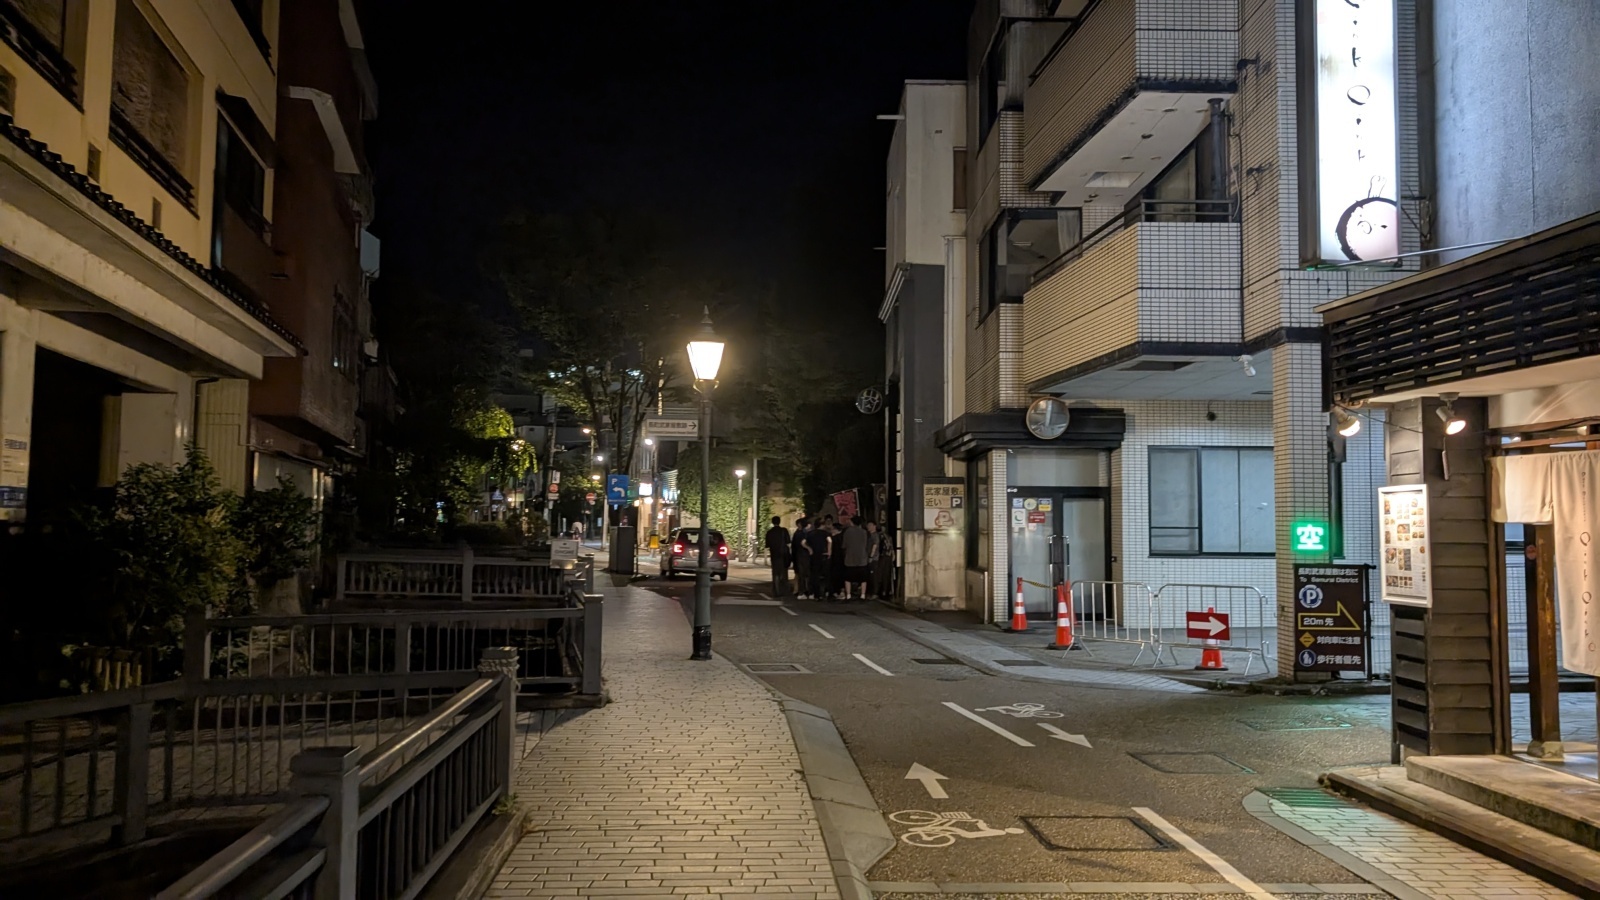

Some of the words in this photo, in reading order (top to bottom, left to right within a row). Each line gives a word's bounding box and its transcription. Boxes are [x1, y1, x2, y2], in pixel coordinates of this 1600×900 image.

[925, 498, 943, 507] 近い
[952, 498, 961, 507] P
[1296, 523, 1324, 550] 空
[1306, 590, 1317, 604] P
[1303, 617, 1324, 626] 20m
[1325, 617, 1334, 626] 先
[1316, 635, 1361, 645] 対向車に注意
[1316, 655, 1361, 665] 歩行者優先
